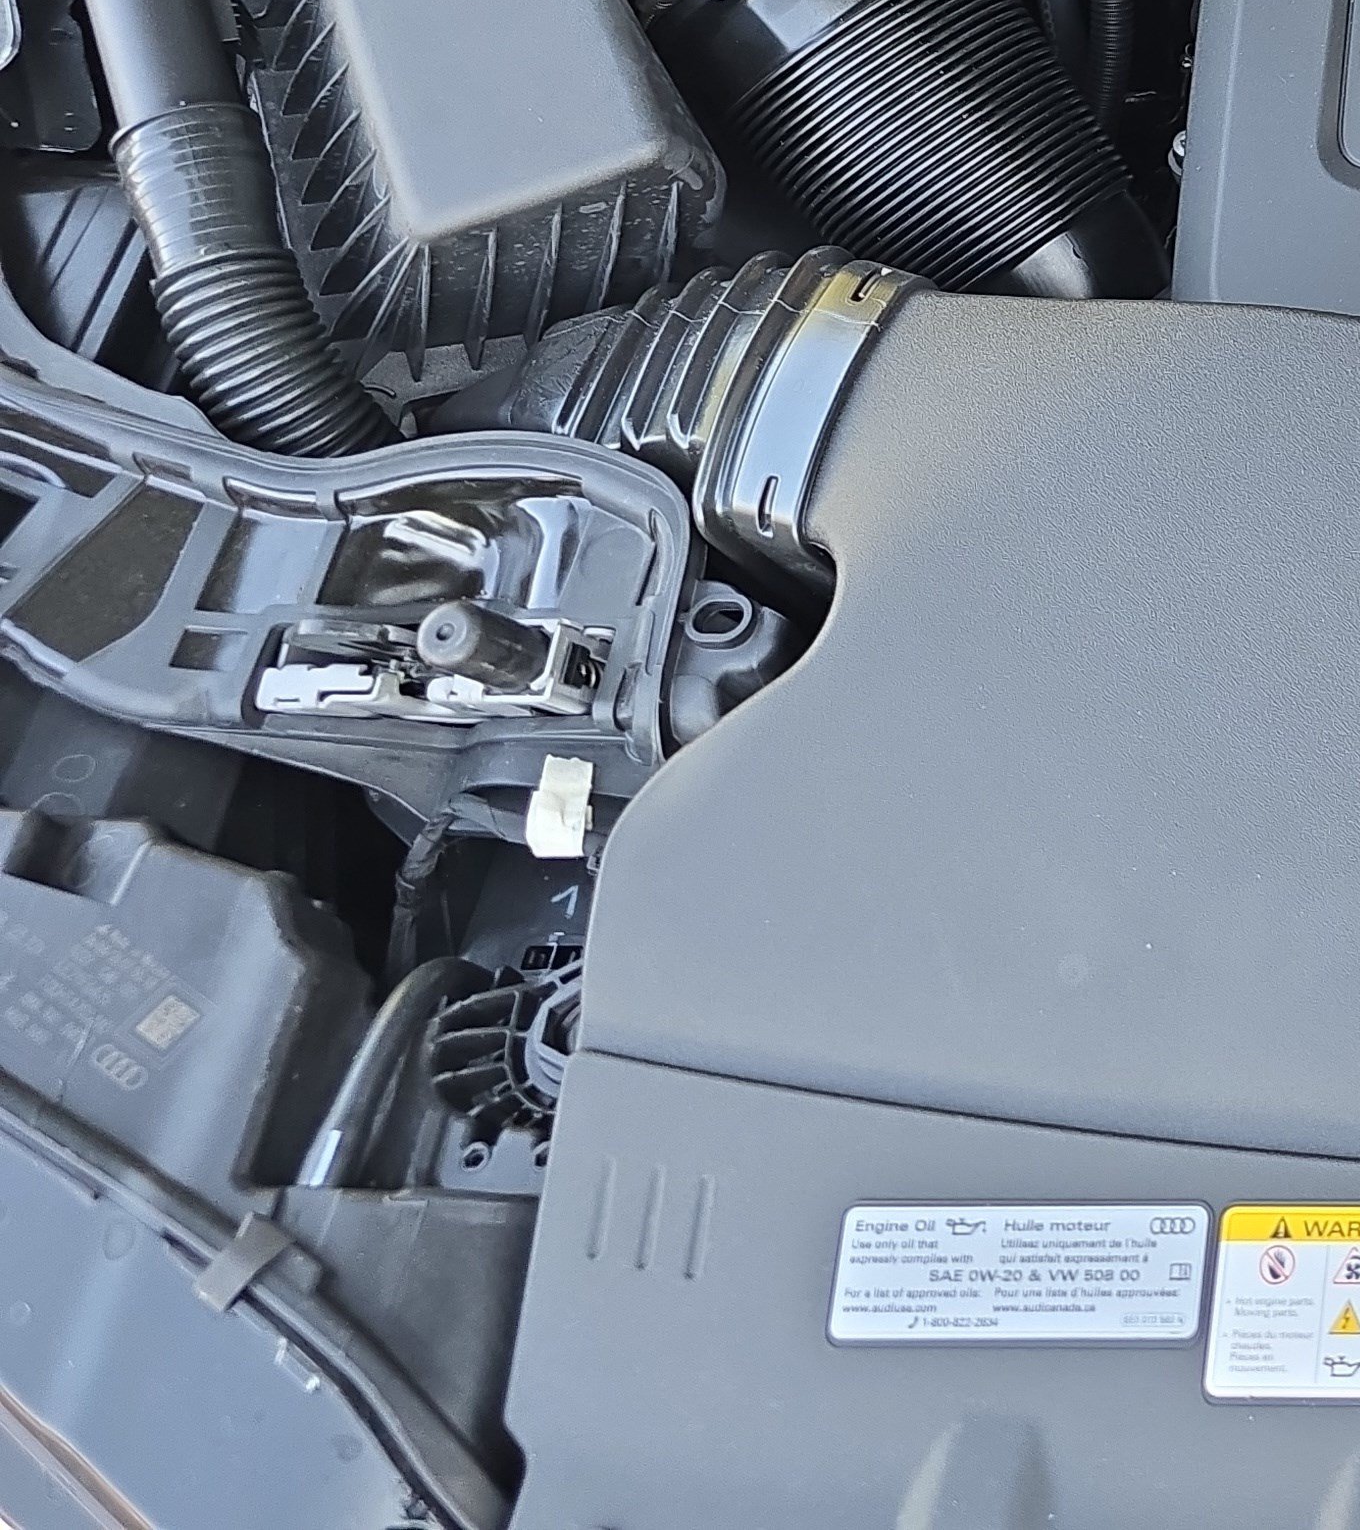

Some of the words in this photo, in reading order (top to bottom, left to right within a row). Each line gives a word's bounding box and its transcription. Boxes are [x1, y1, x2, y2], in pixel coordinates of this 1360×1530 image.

[855, 1220, 909, 1234] Engine
[914, 1220, 937, 1232] Oil
[1003, 1219, 1044, 1232] Huile
[1049, 1220, 1111, 1232] moteur
[851, 1239, 872, 1249] Use
[875, 1239, 897, 1251] only
[901, 1239, 914, 1249] oil
[918, 1239, 938, 1249] that
[1042, 1239, 1106, 1251] uniquement
[1109, 1239, 1122, 1249] de
[951, 1253, 973, 1264] with
[999, 1254, 1016, 1266] qui
[928, 1269, 963, 1282] SAE
[968, 1269, 1023, 1282] 0W-20
[1028, 1269, 1041, 1282] &
[1049, 1269, 1079, 1281] VW
[1083, 1269, 1115, 1282] 508
[1119, 1269, 1141, 1282] 00
[844, 1287, 861, 1298] For
[874, 1287, 890, 1298] list
[892, 1287, 904, 1298] of
[906, 1288, 957, 1300] approved
[994, 1287, 1018, 1298] Pour
[1022, 1289, 1042, 1298] une
